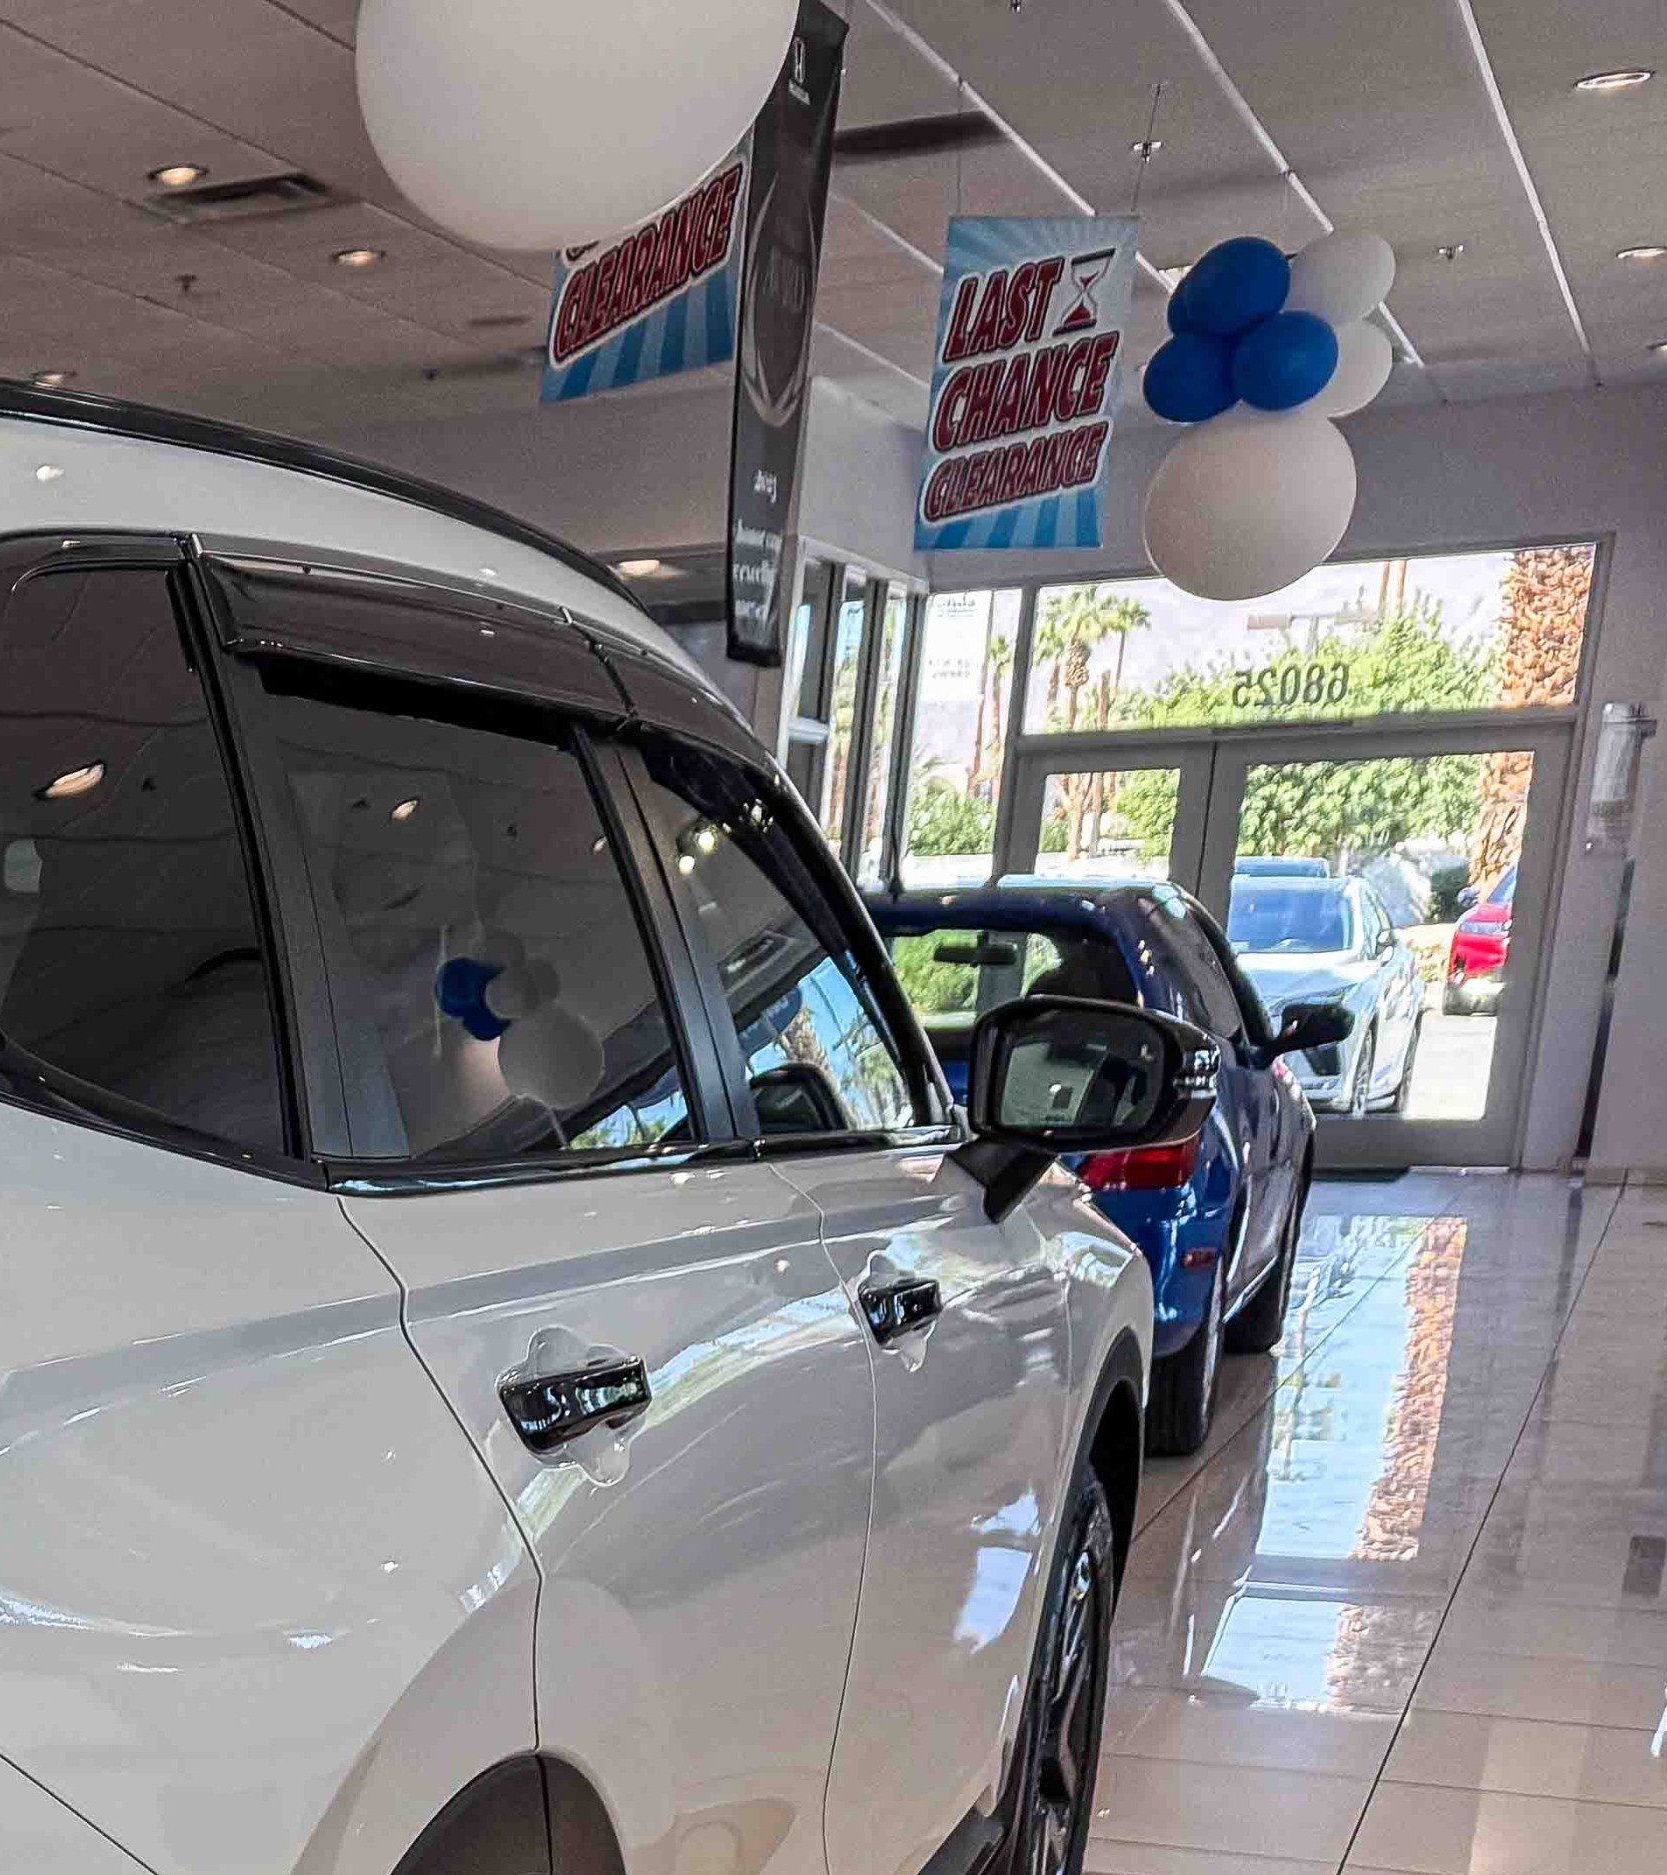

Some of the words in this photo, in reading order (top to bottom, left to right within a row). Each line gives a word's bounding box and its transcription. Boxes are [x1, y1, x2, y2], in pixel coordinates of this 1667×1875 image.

[551, 160, 744, 364] CLEARANCE
[943, 256, 1066, 363] LAST
[933, 330, 1120, 451] CHANCE
[924, 421, 1110, 522] CLEARANCE
